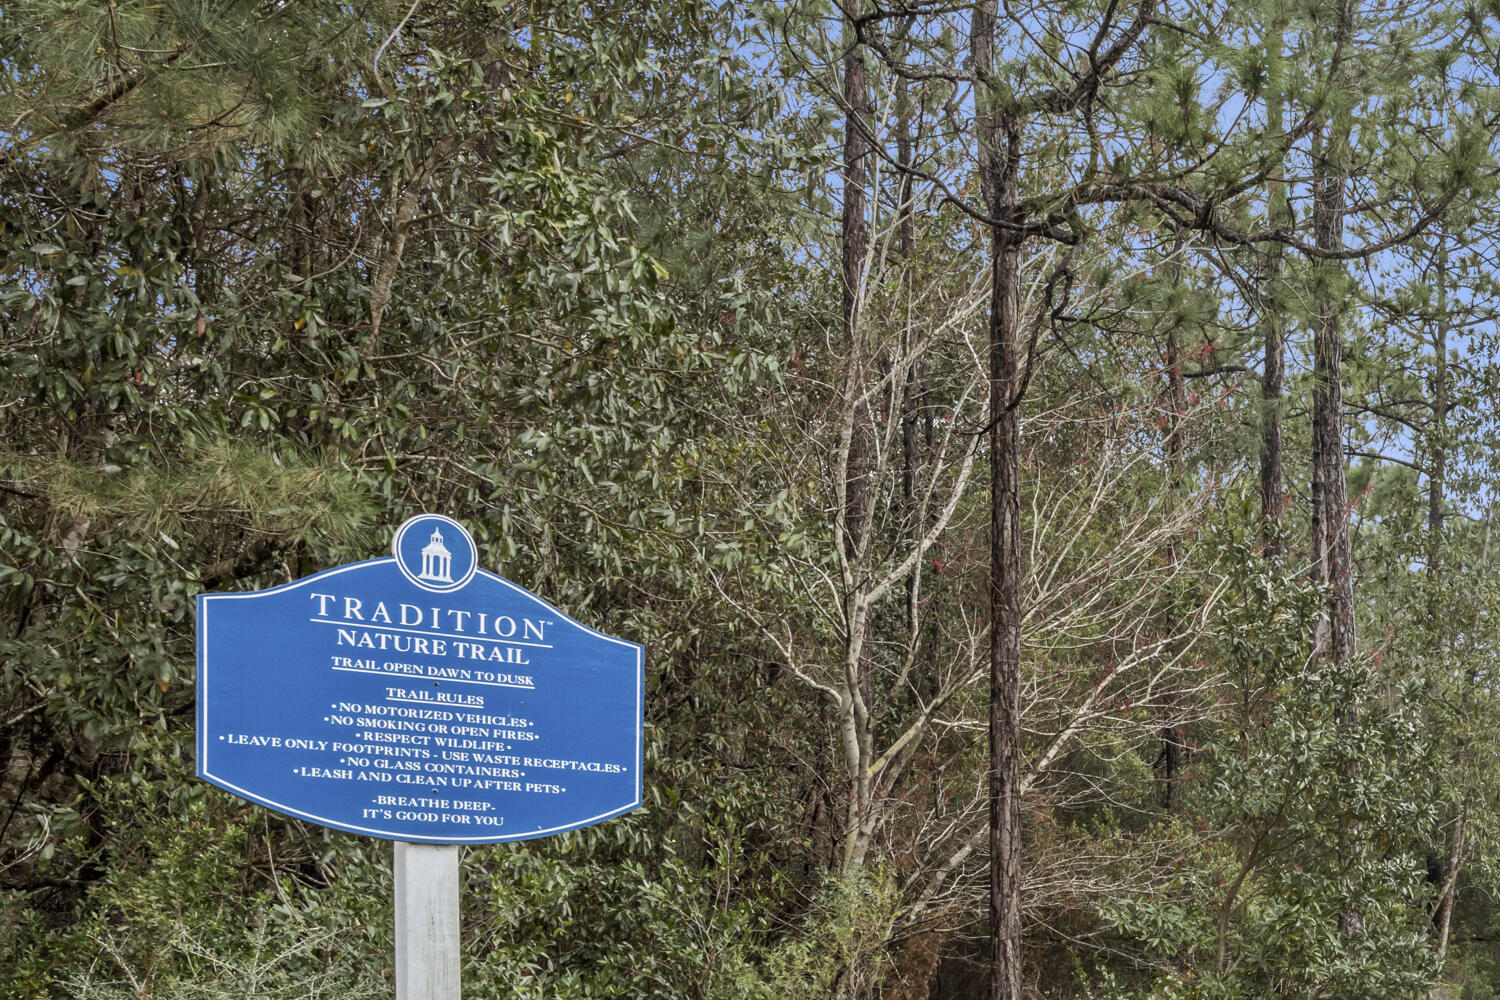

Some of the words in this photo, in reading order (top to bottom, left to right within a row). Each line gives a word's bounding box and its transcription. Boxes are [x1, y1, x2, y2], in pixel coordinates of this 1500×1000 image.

[337, 629, 448, 656] NATURE
[453, 642, 530, 665] TRAIL
[332, 656, 379, 672] TRAIL
[383, 661, 424, 675] OPEN
[427, 665, 471, 680] DAWN
[474, 670, 494, 682] TO
[497, 672, 535, 686] DUSK
[386, 688, 434, 701] TRAIL
[436, 692, 484, 706] RULES
[364, 705, 453, 722] MOTORIZED
[356, 718, 425, 733] SMOKING
[428, 723, 448, 734] OR
[451, 725, 489, 738] OPEN
[285, 738, 329, 751] ONLY
[332, 743, 430, 760] FOOTPRINTS
[441, 751, 469, 763] USE
[472, 753, 521, 767] WASTE
[372, 759, 421, 772] GLASS
[356, 771, 392, 783] AND
[395, 774, 447, 787] CLEAN
[450, 777, 471, 788] UP
[473, 778, 522, 791] AFTER
[363, 808, 392, 820] IT'S
[395, 809, 438, 823] GOOD
[441, 812, 471, 824] FOR
[473, 814, 504, 826] YOU
